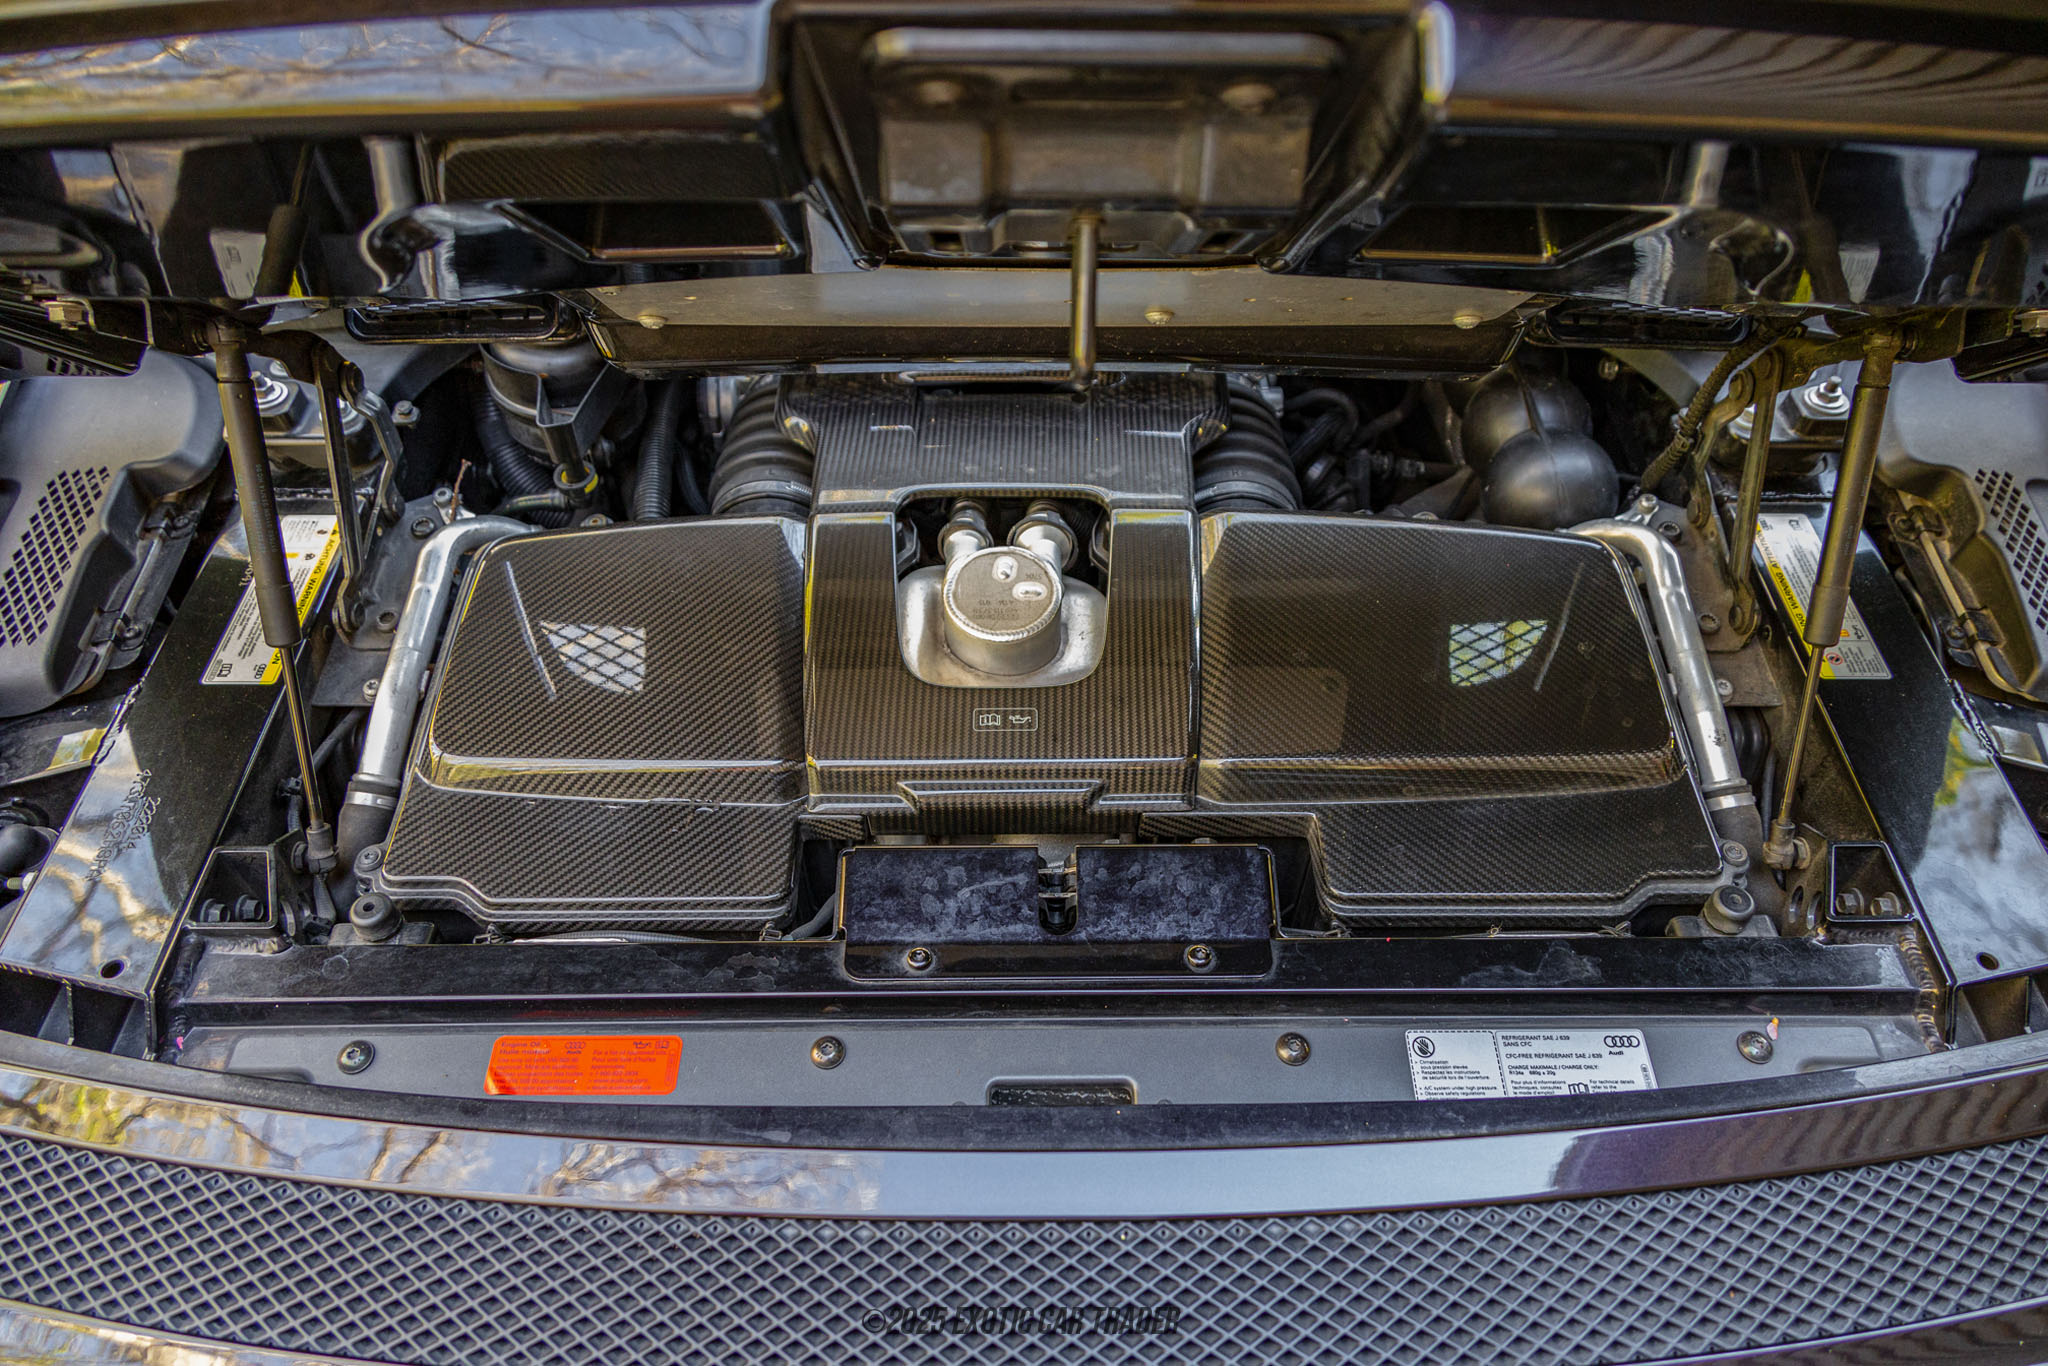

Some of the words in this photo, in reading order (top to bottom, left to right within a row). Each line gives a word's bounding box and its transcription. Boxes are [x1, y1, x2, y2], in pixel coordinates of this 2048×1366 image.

[314, 539, 336, 574] ACHTUNG
[297, 578, 317, 616] WARNING
[1776, 572, 1799, 610] WARNING
